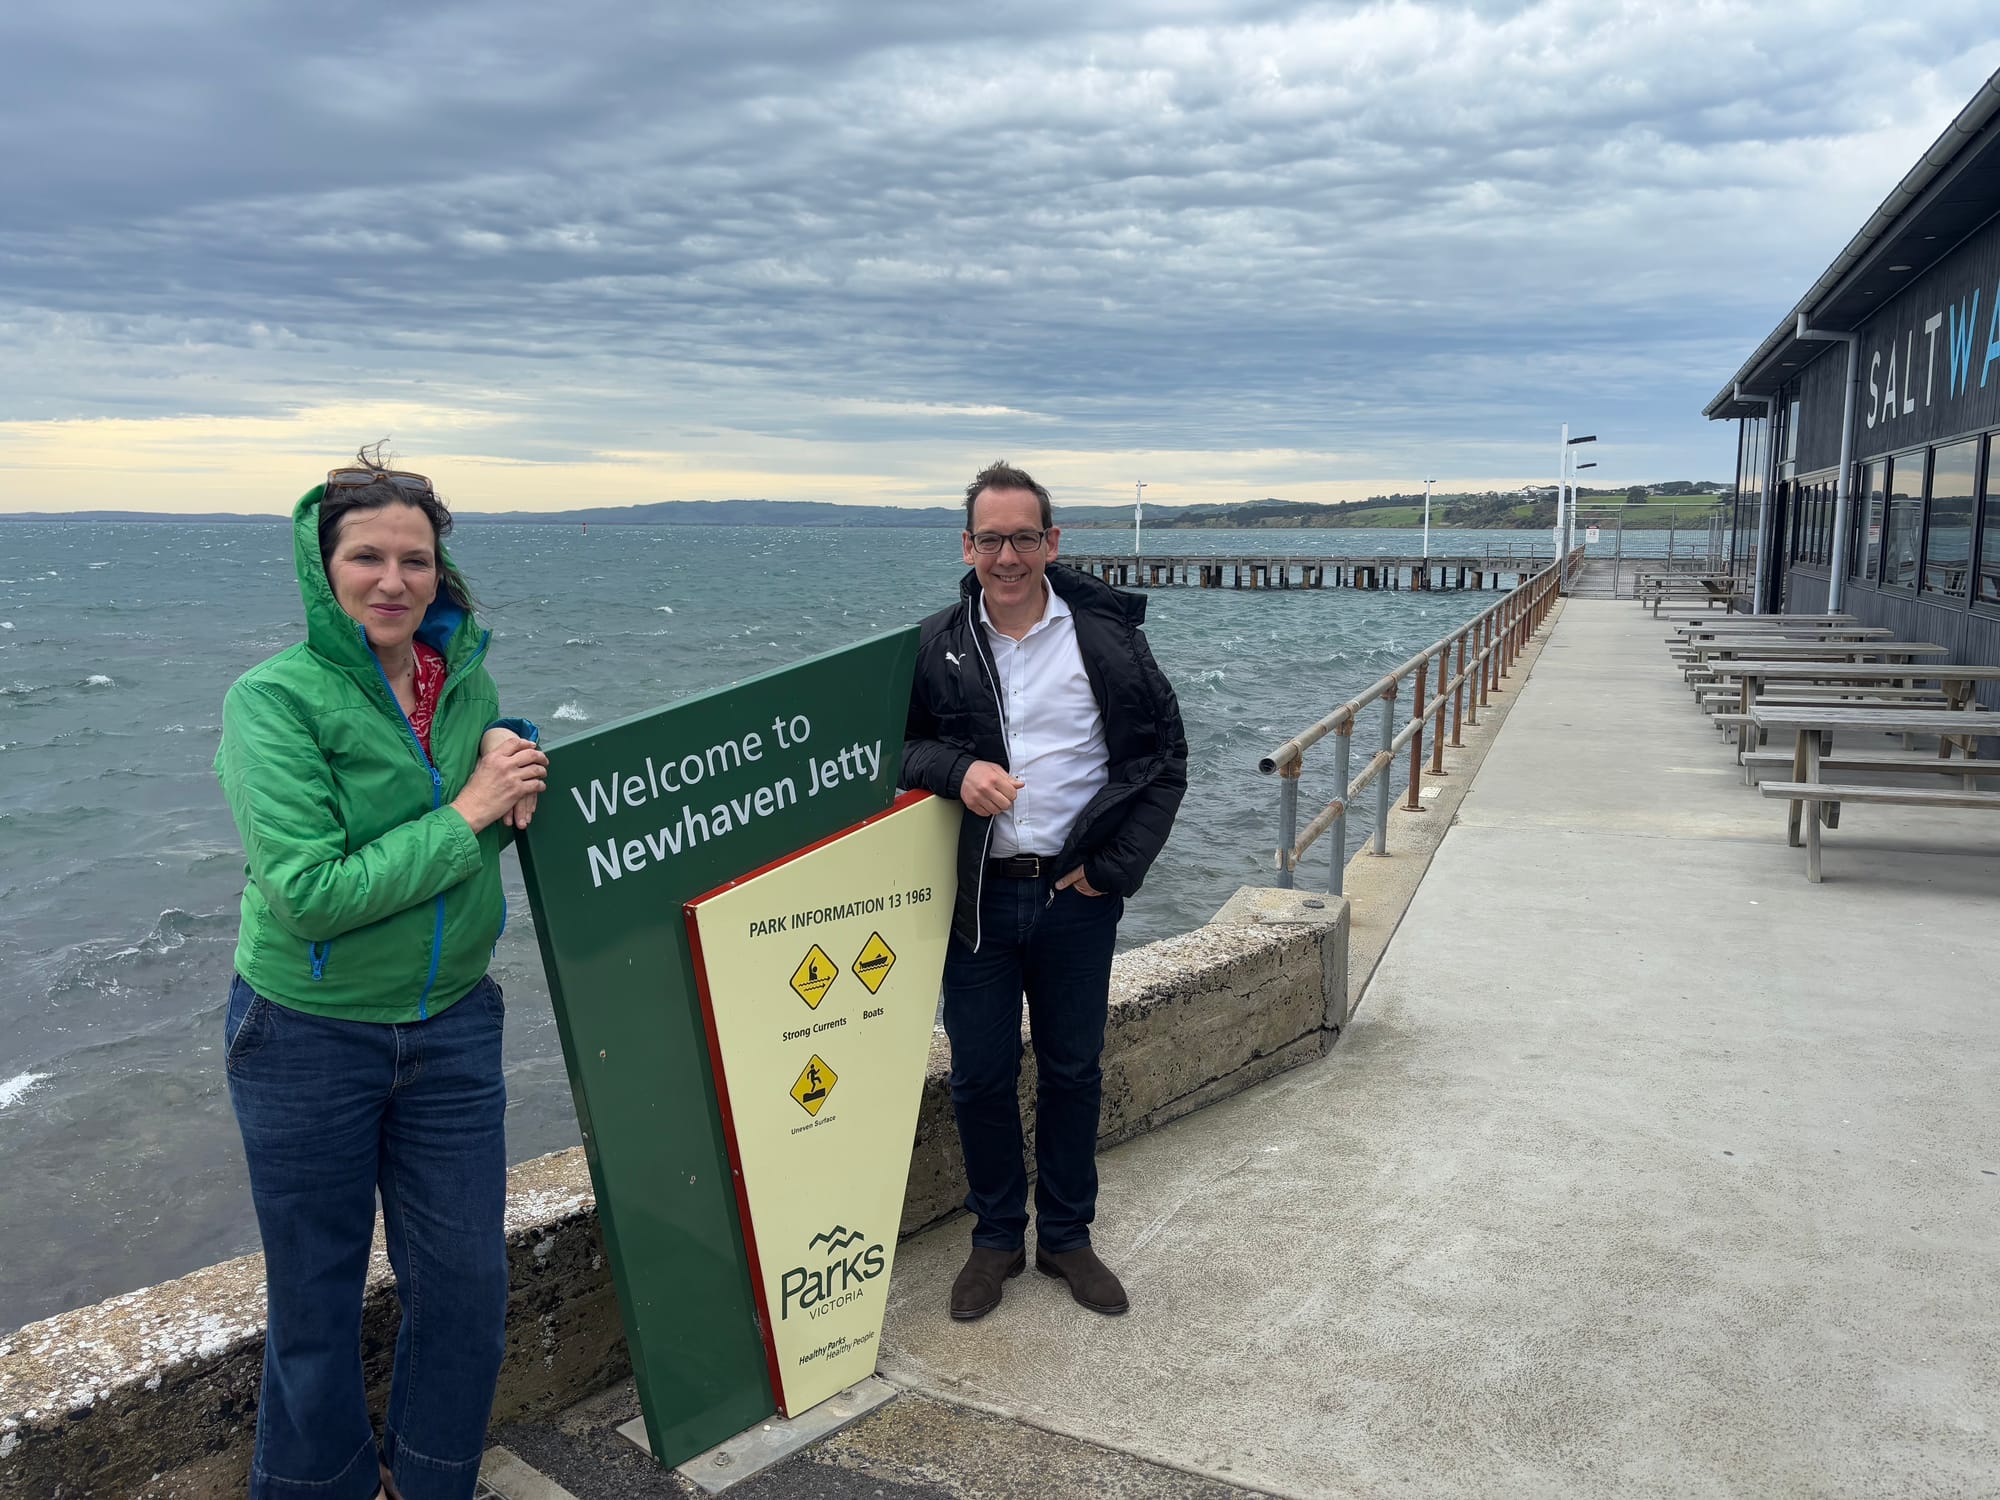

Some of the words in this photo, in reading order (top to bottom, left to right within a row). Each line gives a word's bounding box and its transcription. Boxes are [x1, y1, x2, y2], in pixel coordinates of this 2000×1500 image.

[571, 730, 763, 825] Welcome
[771, 713, 812, 750] to
[586, 776, 798, 888] Newhaven
[807, 739, 882, 798] Jetty
[749, 916, 787, 938] PARK
[791, 897, 884, 930] INFORMATION
[888, 893, 902, 909] 13
[905, 887, 932, 905] 1963
[782, 1026, 811, 1042] Strong
[812, 1016, 847, 1034] Currents
[863, 1006, 884, 1020] Boats
[791, 1121, 814, 1135] Uneven
[814, 1115, 836, 1128] Surface
[781, 1243, 885, 1321] Parks
[809, 1287, 864, 1320] VICTORIA
[799, 1345, 827, 1366] Healthy
[827, 1336, 846, 1351] Parks
[826, 1342, 853, 1361] Healthy
[853, 1330, 875, 1347] People
